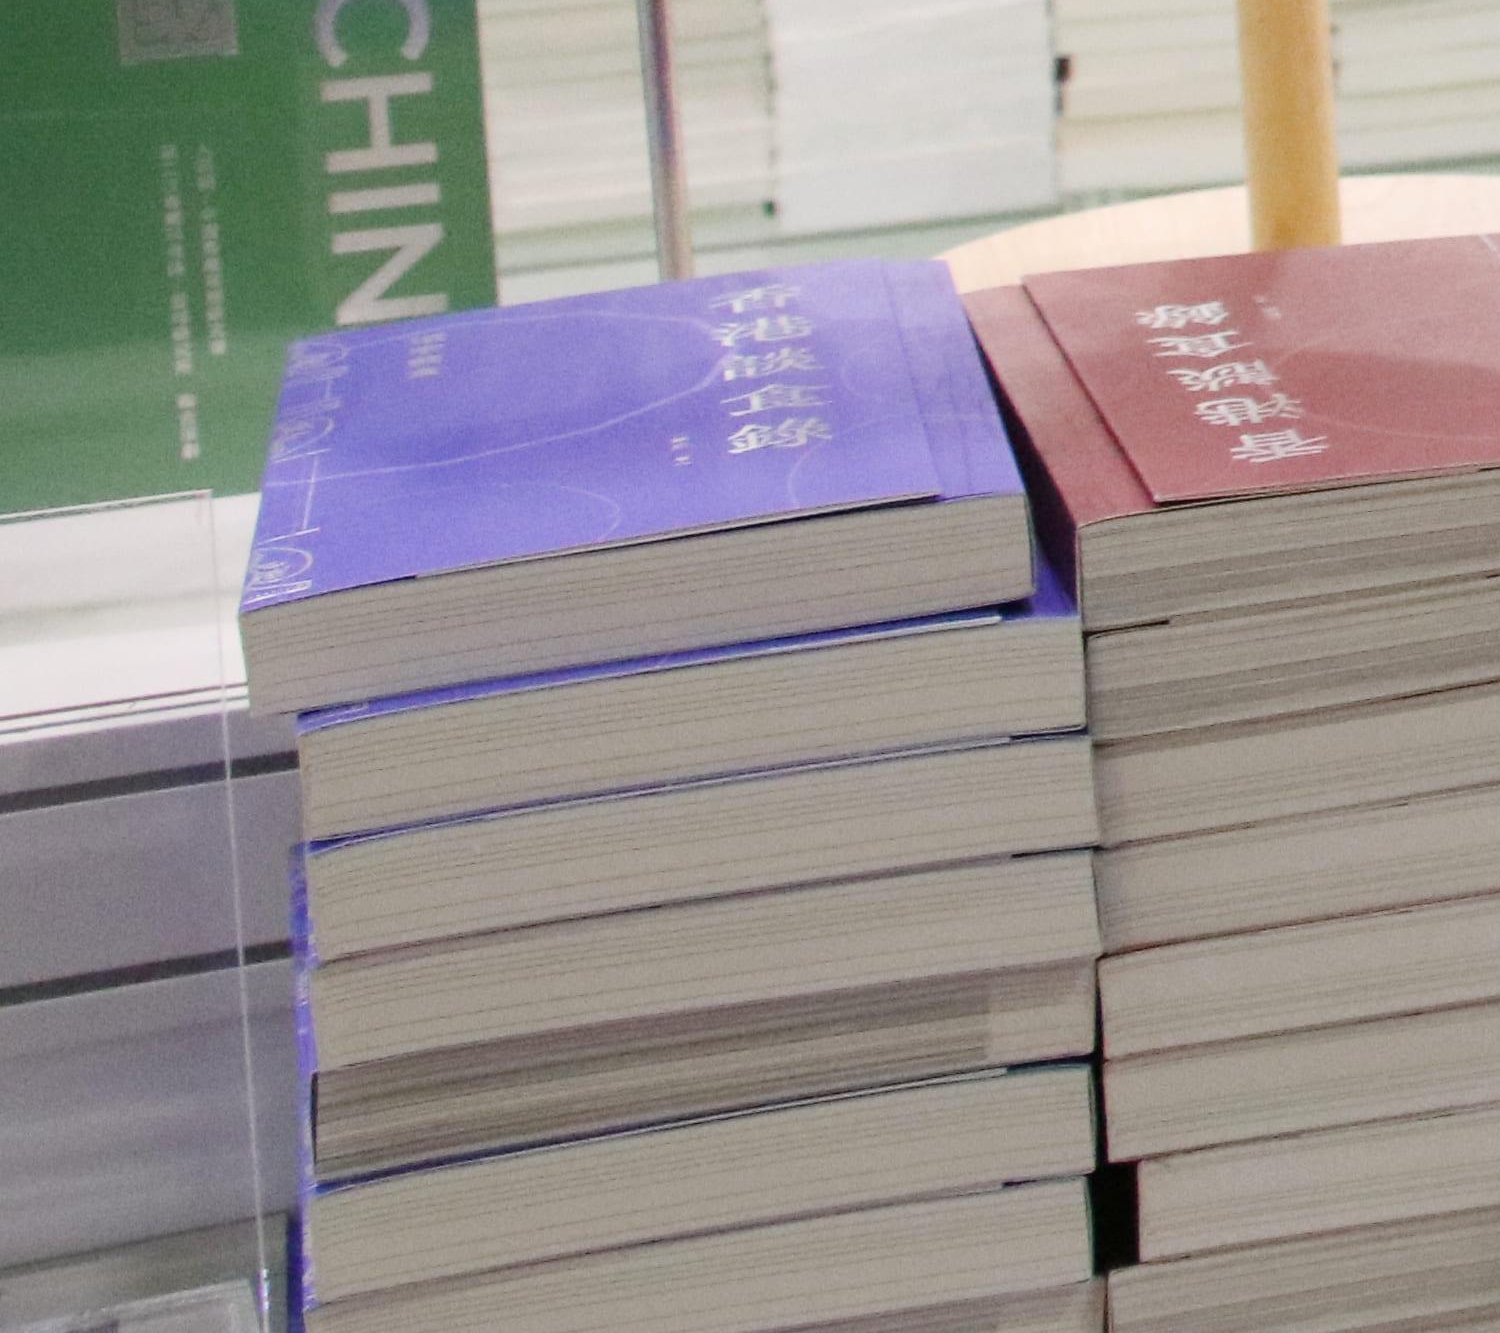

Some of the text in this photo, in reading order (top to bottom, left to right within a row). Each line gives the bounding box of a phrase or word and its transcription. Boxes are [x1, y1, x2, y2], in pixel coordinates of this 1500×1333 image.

[709, 282, 834, 457] 香港談食錄
[1135, 300, 1329, 464] 香港談食錄
